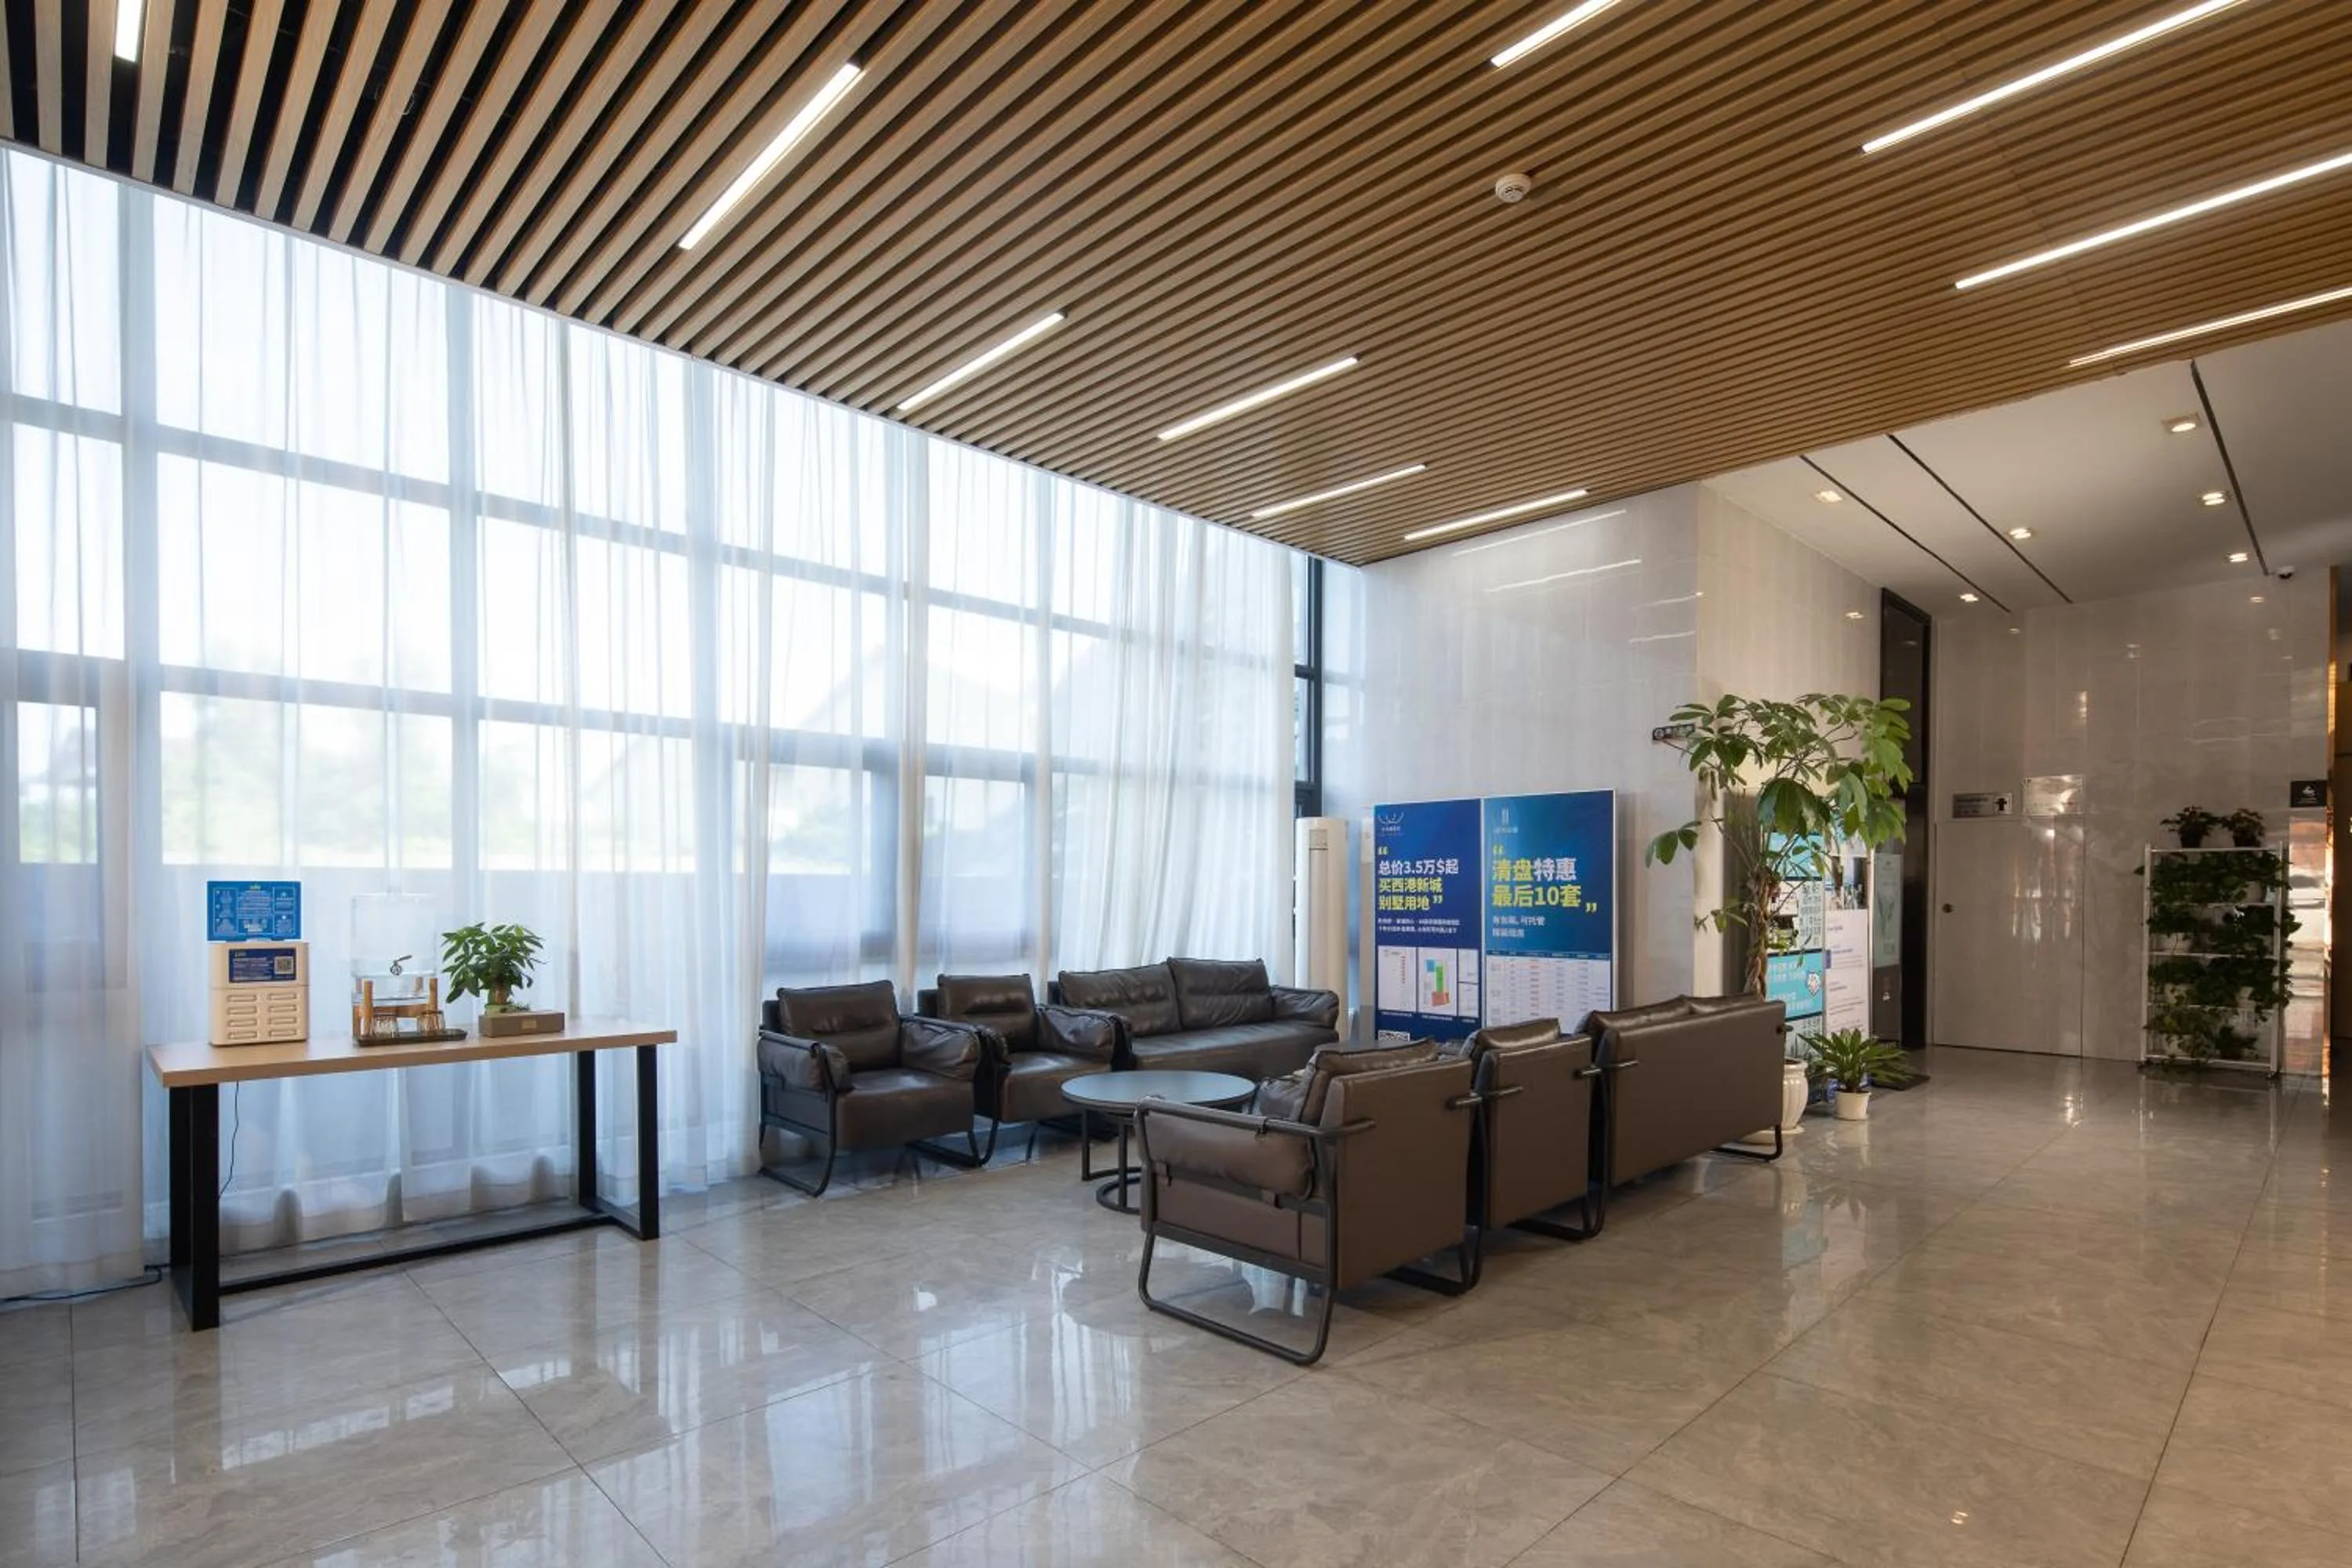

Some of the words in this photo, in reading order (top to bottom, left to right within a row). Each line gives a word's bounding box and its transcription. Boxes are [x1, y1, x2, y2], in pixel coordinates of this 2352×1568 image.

[1378, 857, 1459, 876] 总价3.5万$起
[1492, 857, 1577, 882] 清盘特惠
[1379, 877, 1443, 893] 买西港新城
